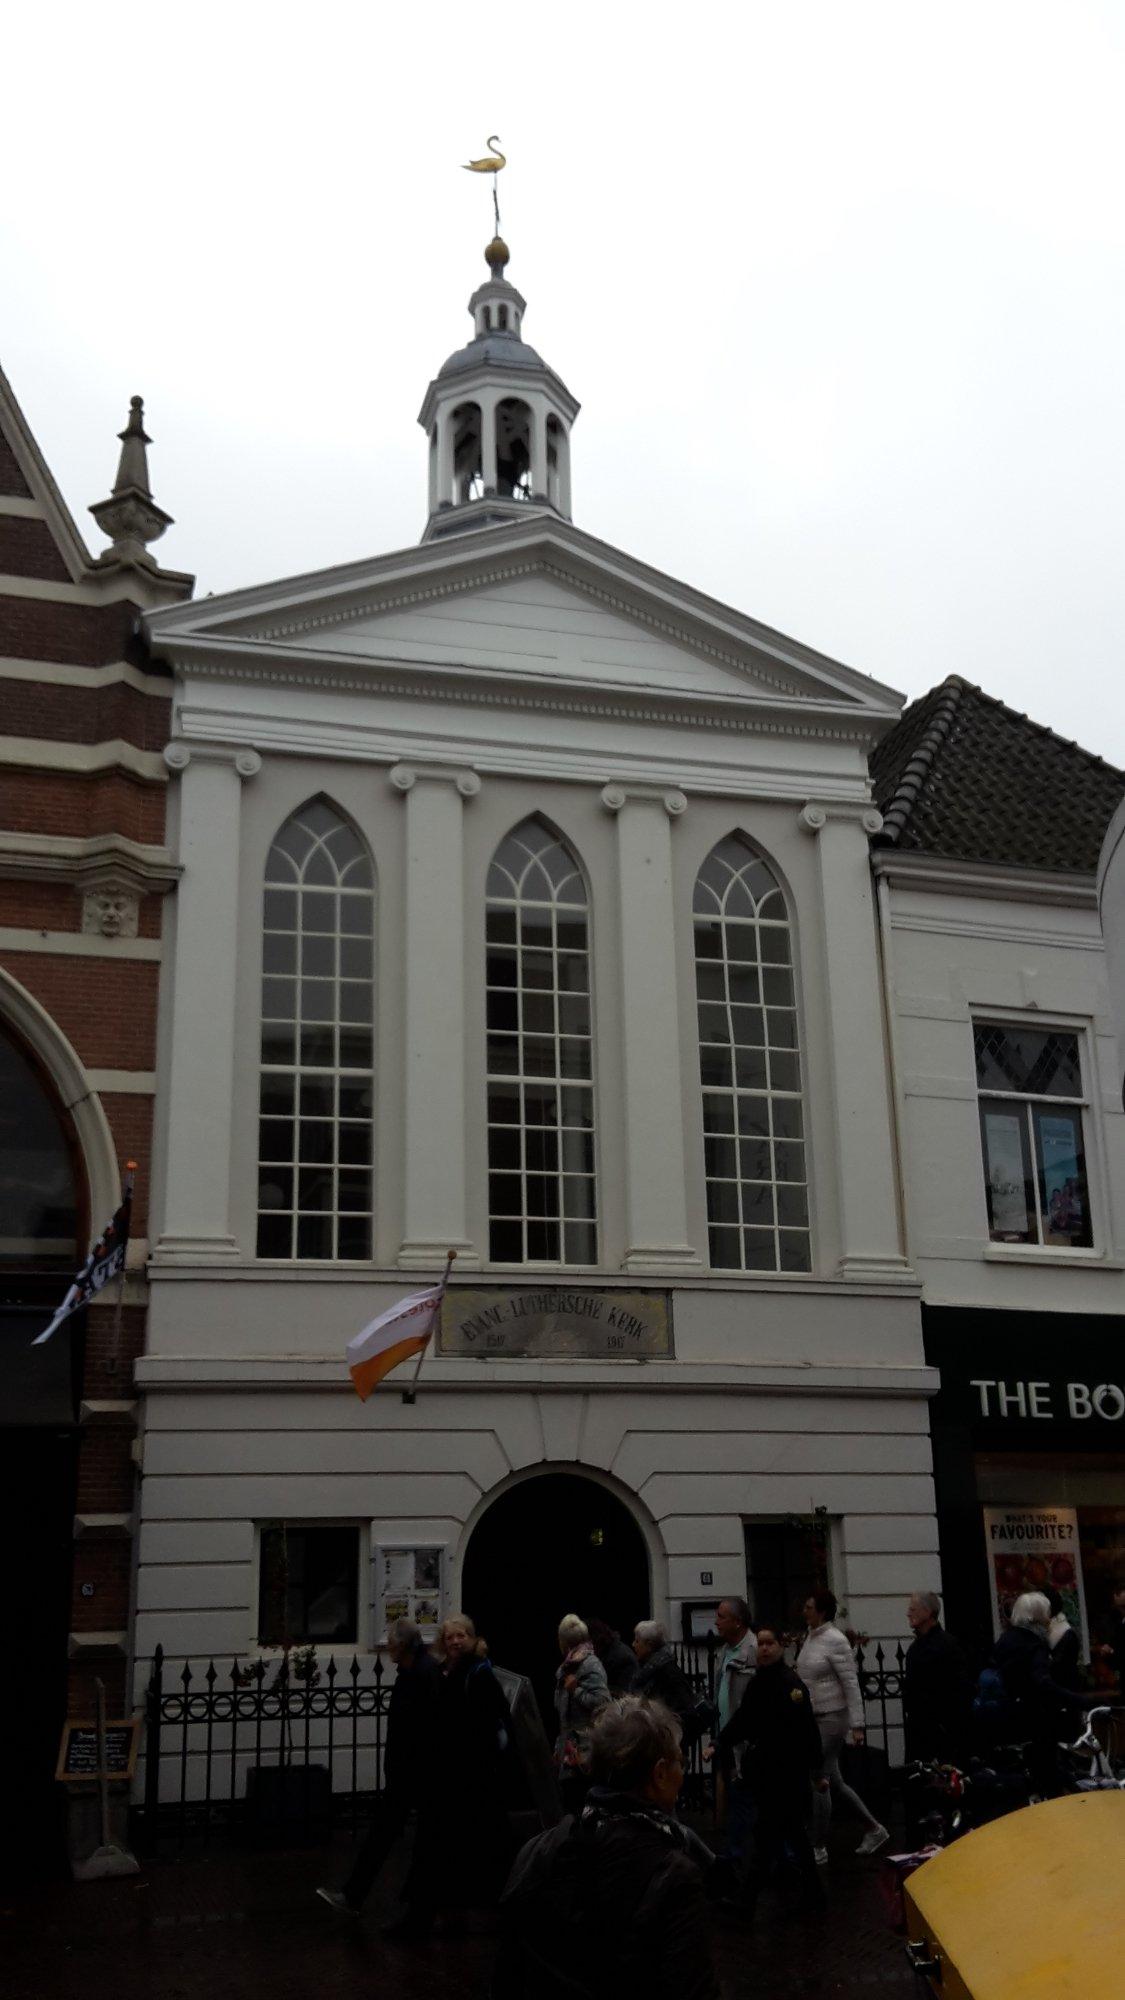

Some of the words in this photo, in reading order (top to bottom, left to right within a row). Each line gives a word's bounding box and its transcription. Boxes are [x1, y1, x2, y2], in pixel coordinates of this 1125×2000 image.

[607, 1306, 648, 1340] KERK
[970, 1380, 1053, 1418] THE
[990, 1524, 1074, 1540] FAVOURITE?
